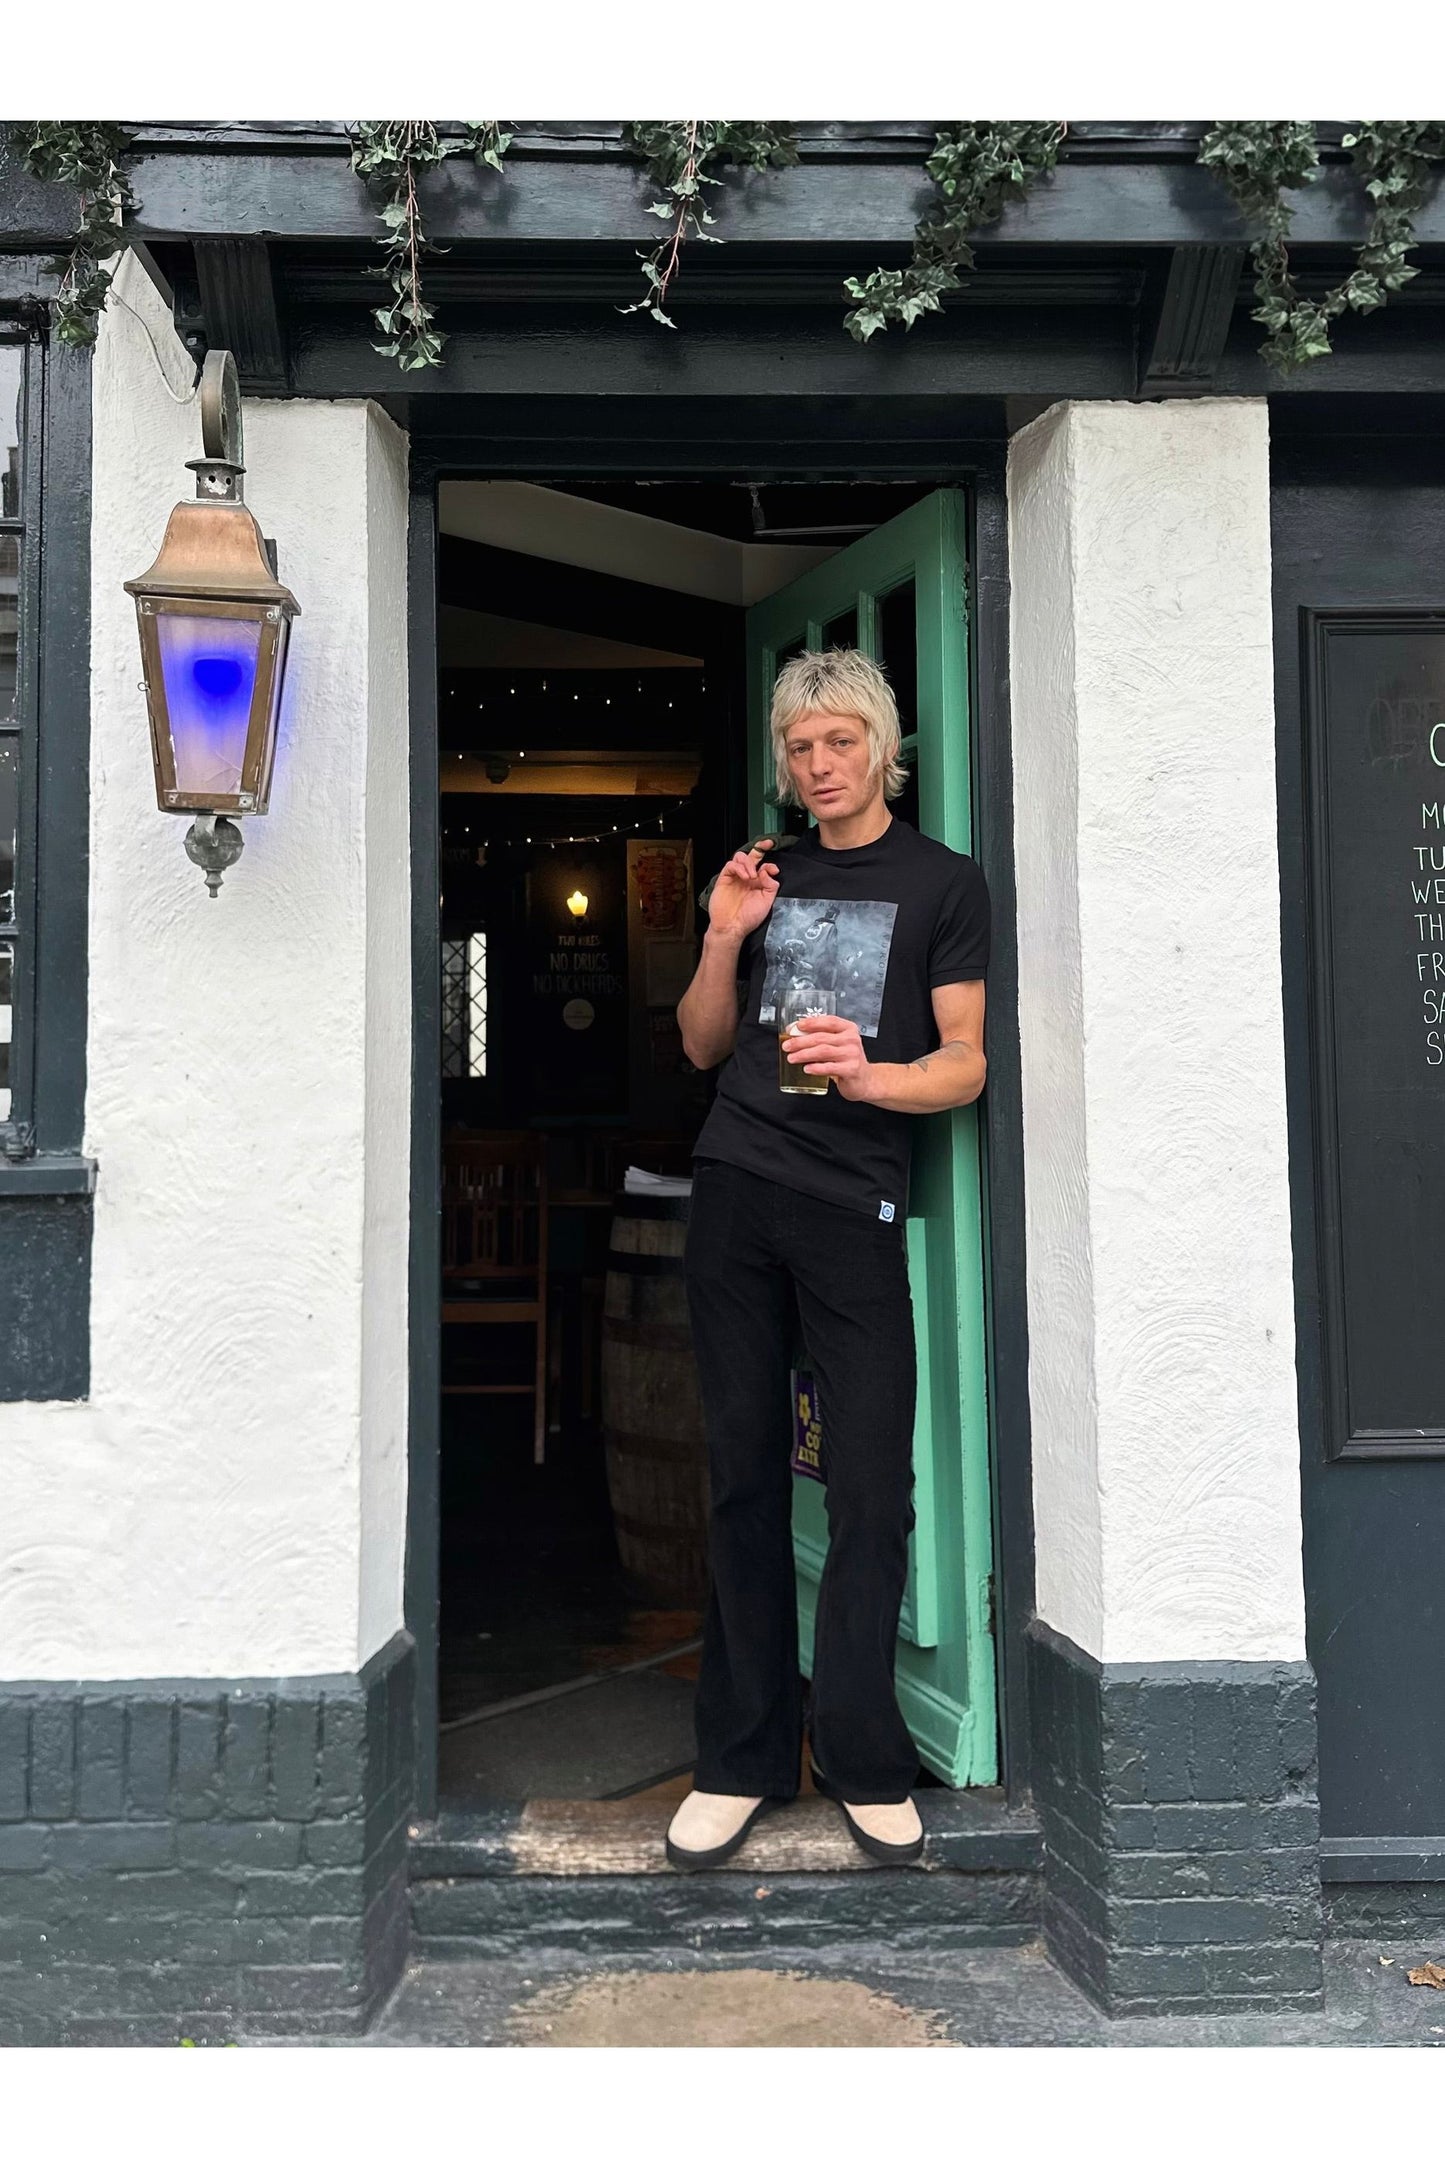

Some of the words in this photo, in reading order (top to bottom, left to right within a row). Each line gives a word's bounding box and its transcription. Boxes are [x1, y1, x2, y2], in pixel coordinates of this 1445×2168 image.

[1421, 802, 1445, 829] M
[549, 952, 569, 972] NO
[533, 974, 553, 994] NO
[1426, 1031, 1445, 1065] S
